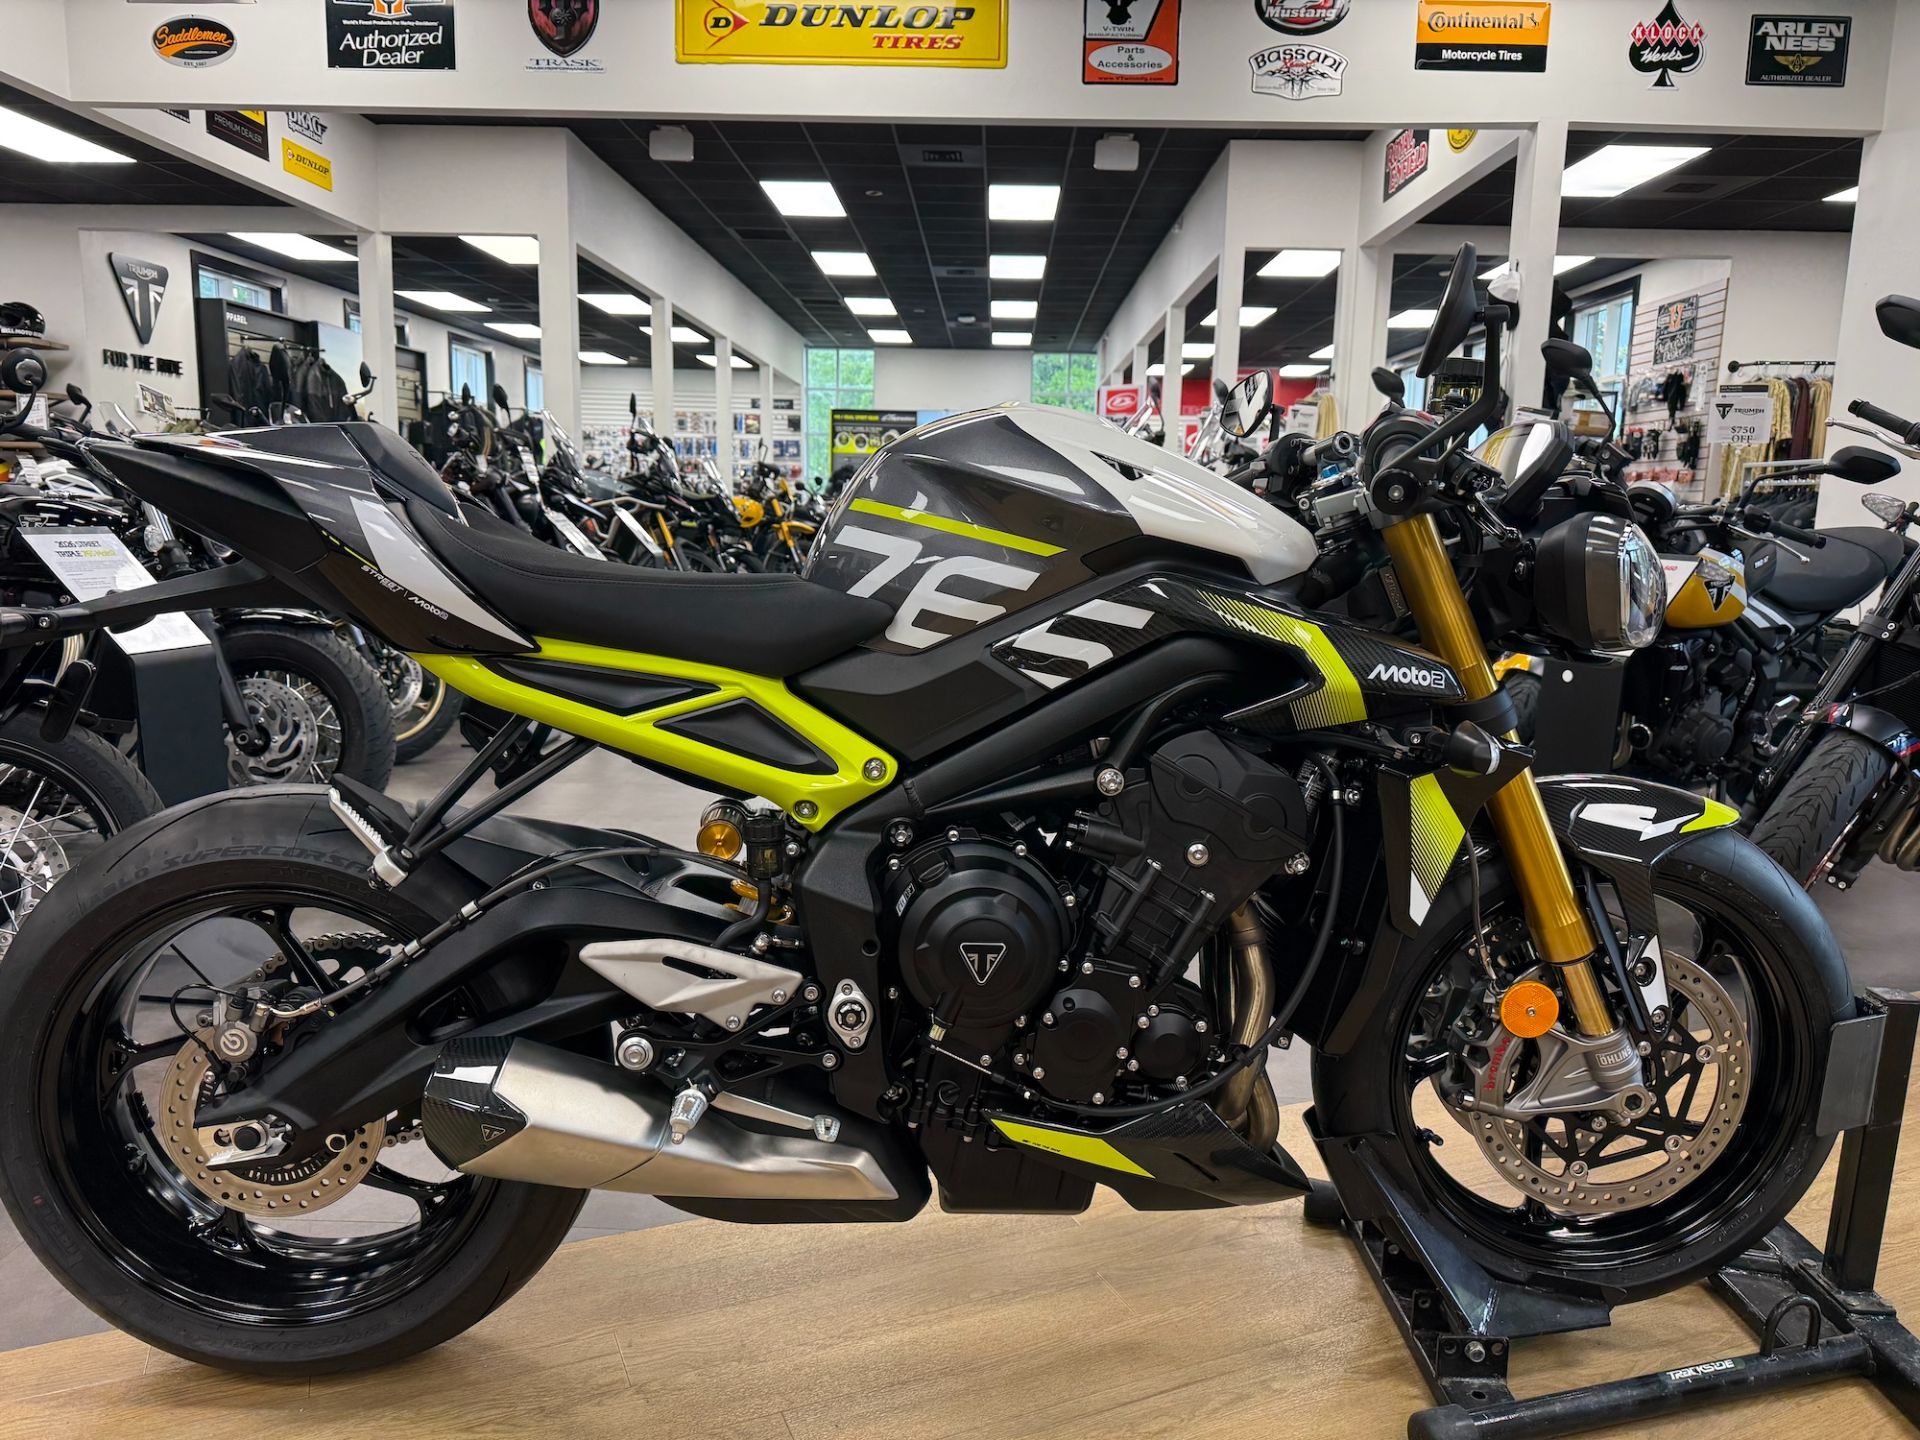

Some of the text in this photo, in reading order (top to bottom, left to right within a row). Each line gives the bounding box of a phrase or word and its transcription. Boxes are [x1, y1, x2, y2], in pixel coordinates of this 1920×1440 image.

[759, 4, 975, 30] DUNLOP
[1265, 5, 1337, 20] Mustang
[1428, 11, 1523, 32] Continental
[1755, 21, 1846, 37] ARLEN
[155, 25, 232, 48] Saddlemen
[339, 25, 443, 51] Authorized
[1635, 27, 1700, 40] KLOCK
[872, 34, 964, 50] TIRES
[1117, 46, 1145, 54] Parts
[1765, 36, 1836, 51] NESS
[363, 45, 424, 66] Dealer
[529, 58, 601, 66] TRASK
[1441, 49, 1522, 61] Motorcycle Tires
[1097, 60, 1163, 68] Accessories
[214, 113, 262, 144] PREMIUM DEALER
[295, 154, 329, 175] DUNLOP
[127, 263, 158, 279] TRIUMPH
[226, 312, 248, 325] PPAREL
[103, 349, 183, 376] FOR THE RIDE
[1731, 426, 1755, 434] $750
[1731, 435, 1753, 443] OFF
[361, 565, 449, 620] STREET Moto2
[1367, 663, 1446, 689] Moto2
[1599, 1046, 1633, 1065] ÖHLINS
[1483, 1036, 1511, 1092] brembo
